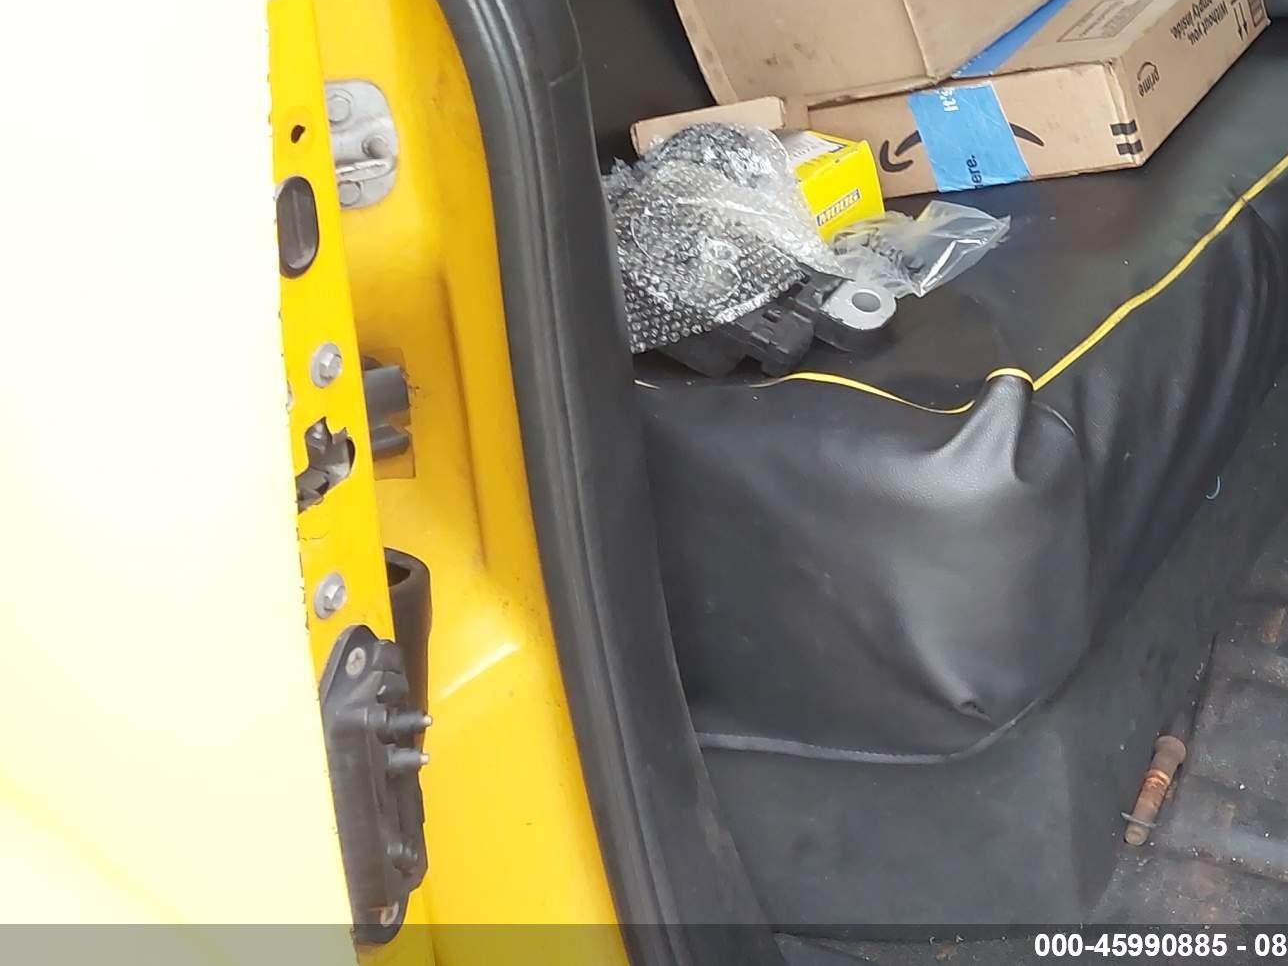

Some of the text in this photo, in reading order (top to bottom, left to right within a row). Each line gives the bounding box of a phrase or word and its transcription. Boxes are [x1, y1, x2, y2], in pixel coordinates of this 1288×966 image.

[1187, 0, 1229, 45] Without you
[1137, 71, 1160, 98] prime
